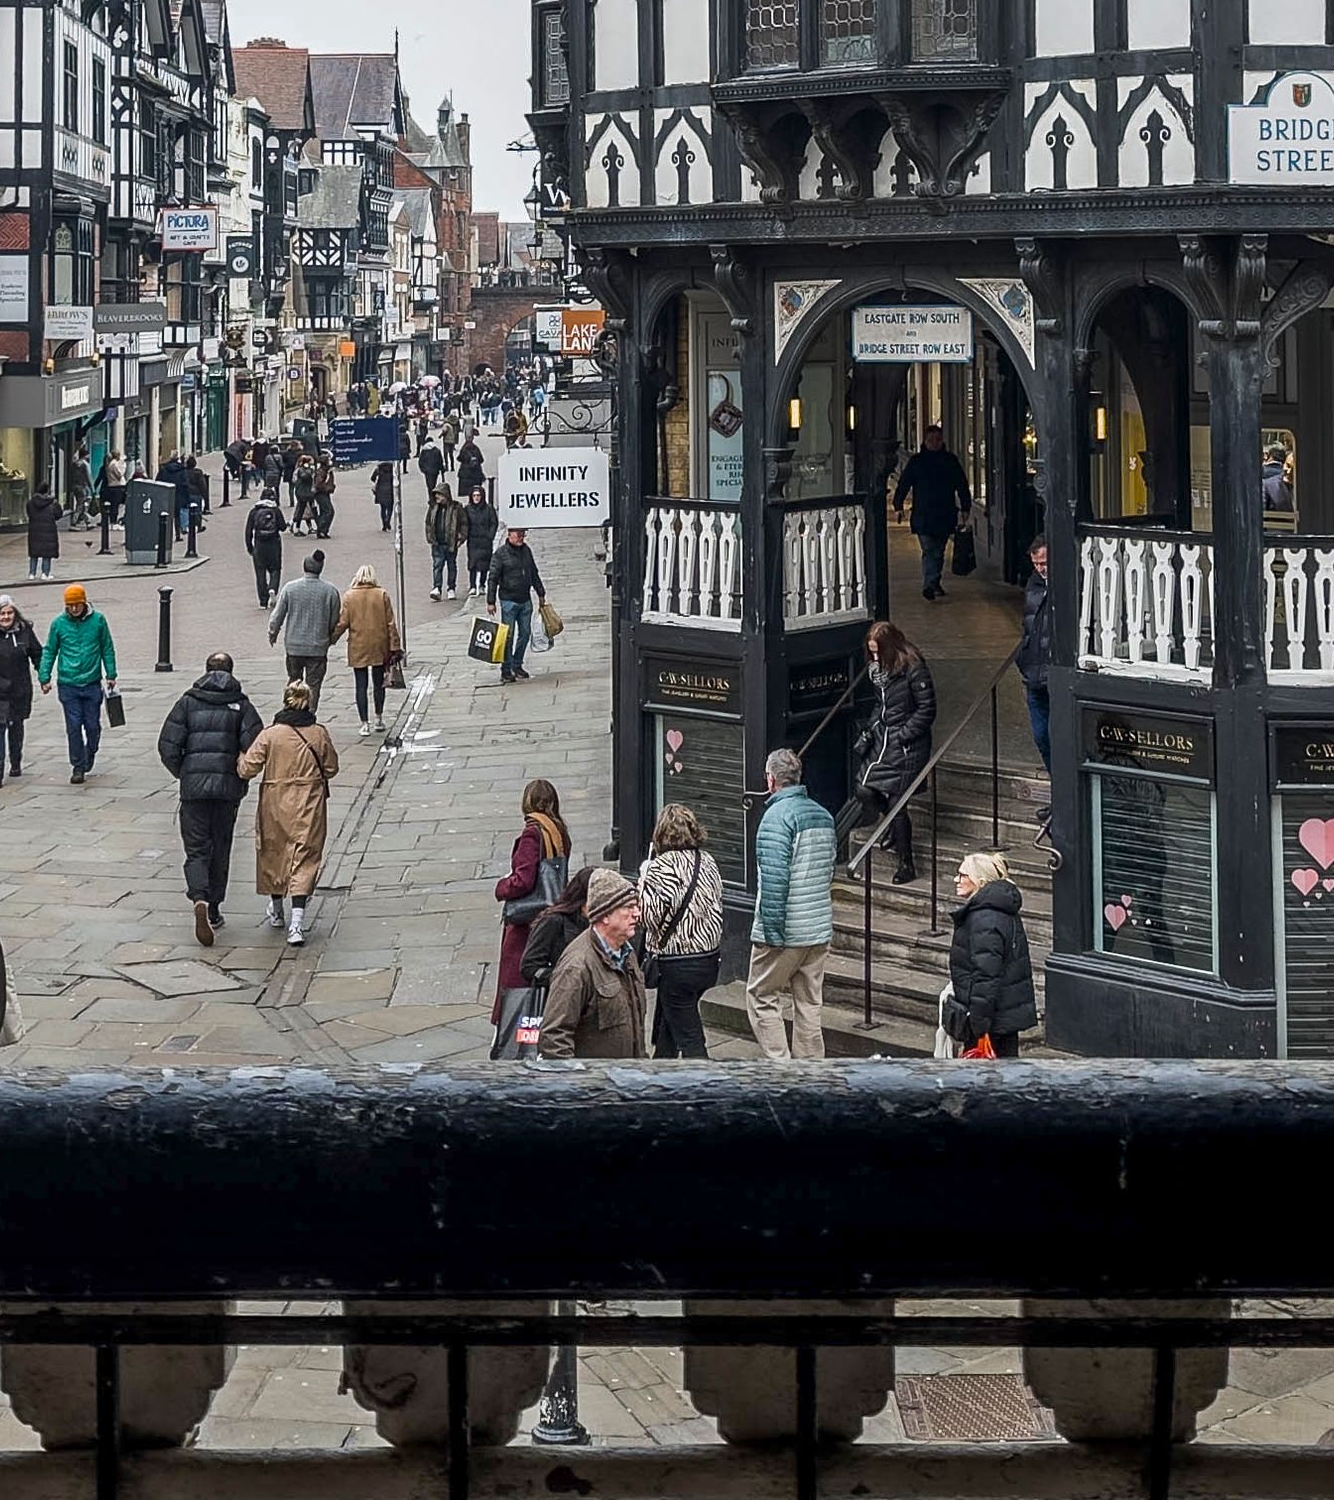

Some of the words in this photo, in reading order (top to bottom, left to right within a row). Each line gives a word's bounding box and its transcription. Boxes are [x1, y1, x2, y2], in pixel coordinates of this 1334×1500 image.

[97, 313, 163, 324] BEAVERBROOKS
[865, 313, 906, 324] EASTGATE
[910, 313, 928, 324] ROW
[931, 313, 960, 324] SOUTH
[563, 324, 598, 338] LAKE
[859, 344, 887, 354] BRIDGE
[889, 343, 920, 354] STREET
[923, 343, 941, 354] ROW
[944, 343, 966, 354] EAST
[519, 465, 588, 482] INFINITY
[509, 492, 600, 509] JEWELLERS
[476, 629, 493, 645] GO
